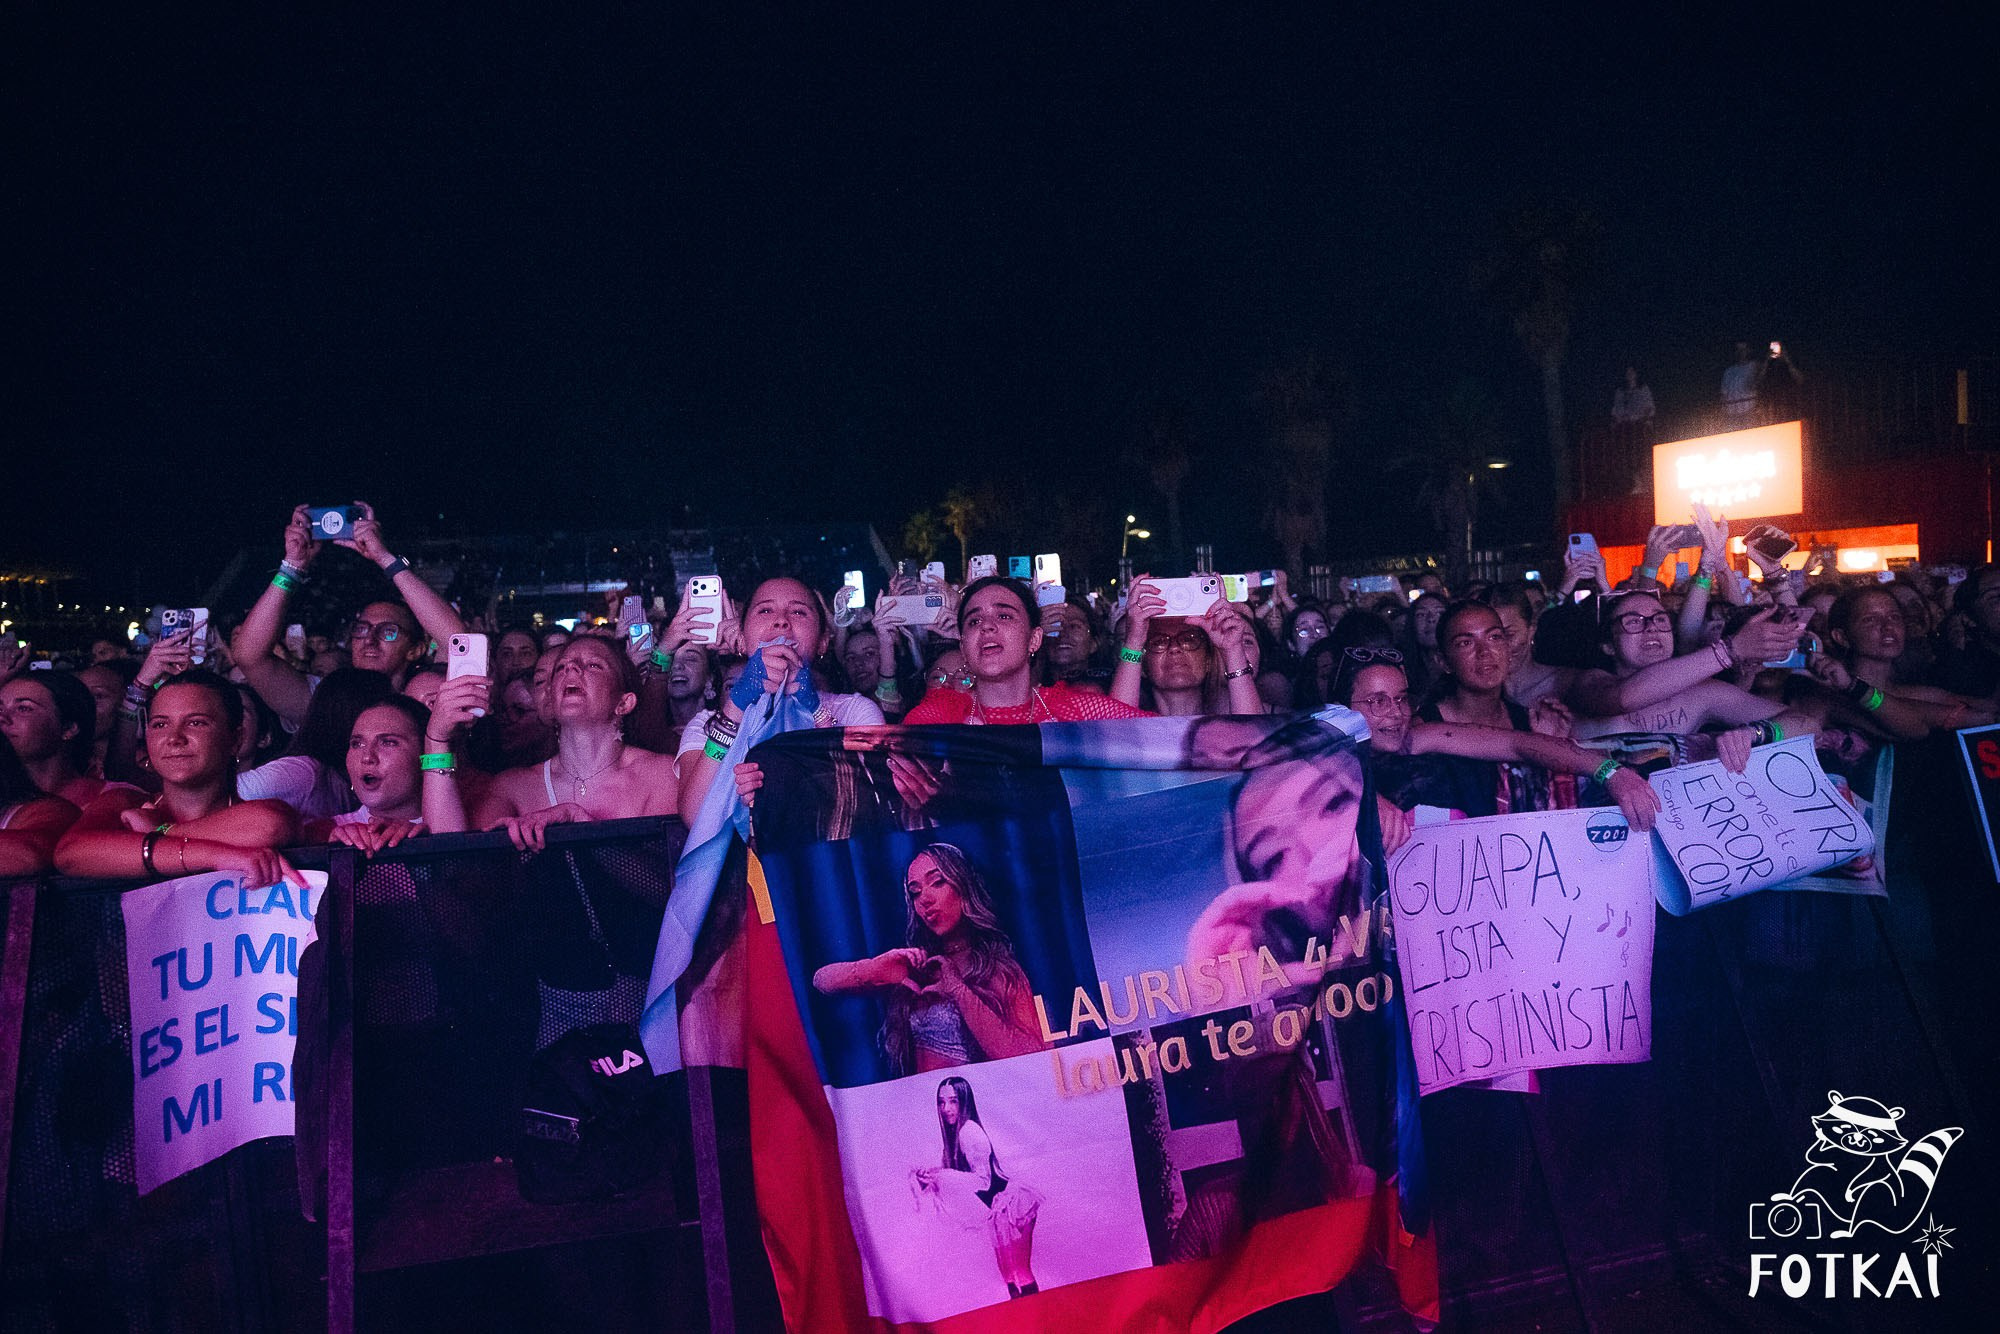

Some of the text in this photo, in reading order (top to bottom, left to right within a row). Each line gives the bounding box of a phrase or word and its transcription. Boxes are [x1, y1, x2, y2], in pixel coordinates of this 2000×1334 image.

[1622, 707, 1688, 733] LAUDIA
[1661, 779, 1685, 831] contigo
[1682, 774, 1774, 885] ERROR
[1765, 751, 1863, 866] OTRA
[1394, 831, 1581, 916] GUAPA,
[152, 942, 213, 1000] TU
[1033, 945, 1292, 1043] LAURISTA
[1406, 915, 1572, 994] LISTA Y
[140, 1017, 182, 1078] ES
[195, 1003, 239, 1055] EL
[1052, 1036, 1192, 1099] laura
[1201, 1019, 1257, 1061] te
[162, 1061, 295, 1143] MI R
